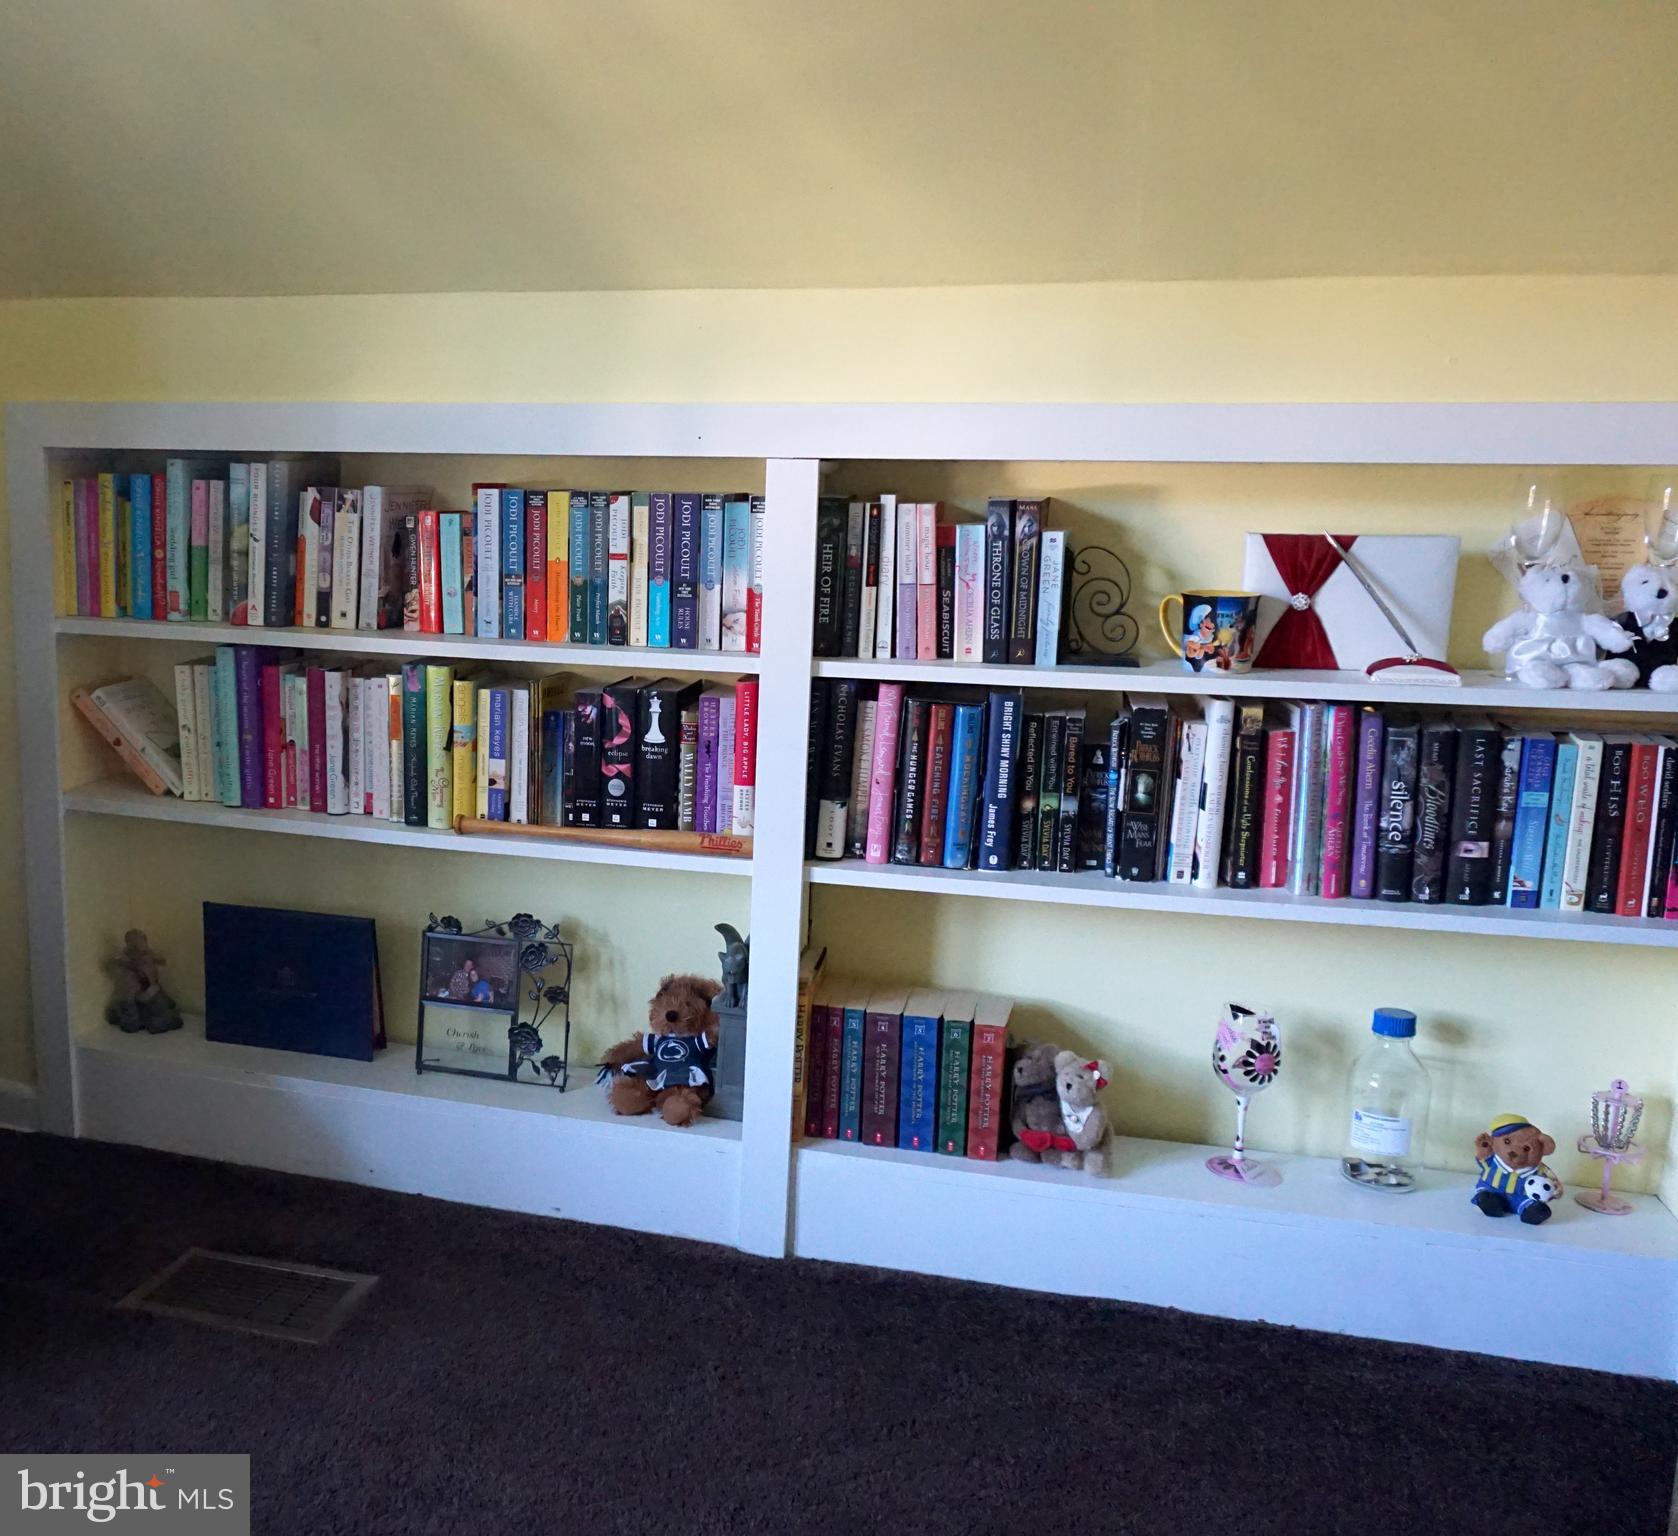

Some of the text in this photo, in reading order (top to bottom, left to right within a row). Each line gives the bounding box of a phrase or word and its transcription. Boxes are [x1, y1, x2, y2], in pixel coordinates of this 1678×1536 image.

[482, 494, 493, 562] JODI PICOULT
[508, 495, 518, 572] JODI PICOULT
[532, 510, 540, 570] JODI PICOULT
[574, 510, 582, 572] JODI PICOULT
[594, 510, 602, 572] JODI PICOULT
[654, 497, 665, 573] JODI PICOULT
[680, 500, 692, 580] JODI PICOULT
[707, 514, 716, 535] JODI
[708, 538, 716, 576] PICOULT
[754, 516, 764, 580] JODI PICOULT
[610, 570, 618, 591] Faith
[618, 565, 626, 594] Keeping
[818, 543, 834, 624] HEIR OF FIRE
[880, 556, 892, 586] diary
[1017, 538, 1031, 640] CROWN OF MIDNIGHT
[1042, 555, 1051, 594] GREEN
[1050, 560, 1060, 590] JANE
[990, 541, 1002, 641] THRONE OF GLASS
[942, 589, 952, 654] SEABISCUIT
[878, 688, 897, 708] My
[493, 693, 503, 757] marian keyes
[742, 718, 750, 738] LADY,
[832, 683, 849, 777] NICHOLAS EVANS
[1218, 728, 1228, 759] chasing
[608, 750, 629, 760] eclipse
[641, 744, 668, 754] breaking
[996, 701, 1014, 800] BRIGHT SHINY MORNING
[1025, 721, 1038, 793] Reflected in You
[1048, 720, 1060, 792] Entwined with You
[1065, 738, 1078, 796] Bared to You
[1364, 727, 1378, 790] Cecelia Ahern
[1664, 756, 1674, 779] david
[267, 748, 276, 794] Jane Green
[330, 773, 338, 800] Green
[684, 752, 694, 788] WALLY
[702, 774, 710, 803] Finishing
[906, 754, 918, 791] HUNGER
[930, 746, 943, 821] CATCHING FIRE
[1218, 760, 1227, 782] harry
[1244, 755, 1256, 799] Confessions
[1468, 738, 1486, 836] LAST SACRIFICE
[1496, 761, 1514, 812] Sarah's Key
[683, 792, 692, 823] LAMB
[905, 791, 915, 819] GAMES
[1188, 781, 1198, 806] worth
[1388, 779, 1410, 842] silence
[1636, 784, 1648, 824] WHO
[1662, 780, 1672, 808] sedaris
[984, 803, 998, 848] James Frey
[1240, 814, 1252, 830] Ugly
[1422, 784, 1446, 850] Bloodlines
[700, 833, 743, 851] Phillies
[1041, 820, 1051, 860] SYLVIA DAY
[1062, 824, 1072, 862] SYLVIA DAY
[1238, 831, 1250, 867] Stepsister
[446, 1028, 480, 1040] Cherish
[849, 1040, 858, 1113] HARRY POTTER
[878, 1043, 887, 1116] HARRY POTTER
[916, 1047, 924, 1081] HARRY
[952, 1051, 960, 1085] HARRY
[984, 1055, 993, 1089] HARRY
[950, 1088, 958, 1124] POTTER
[982, 1093, 991, 1128] POTTER
